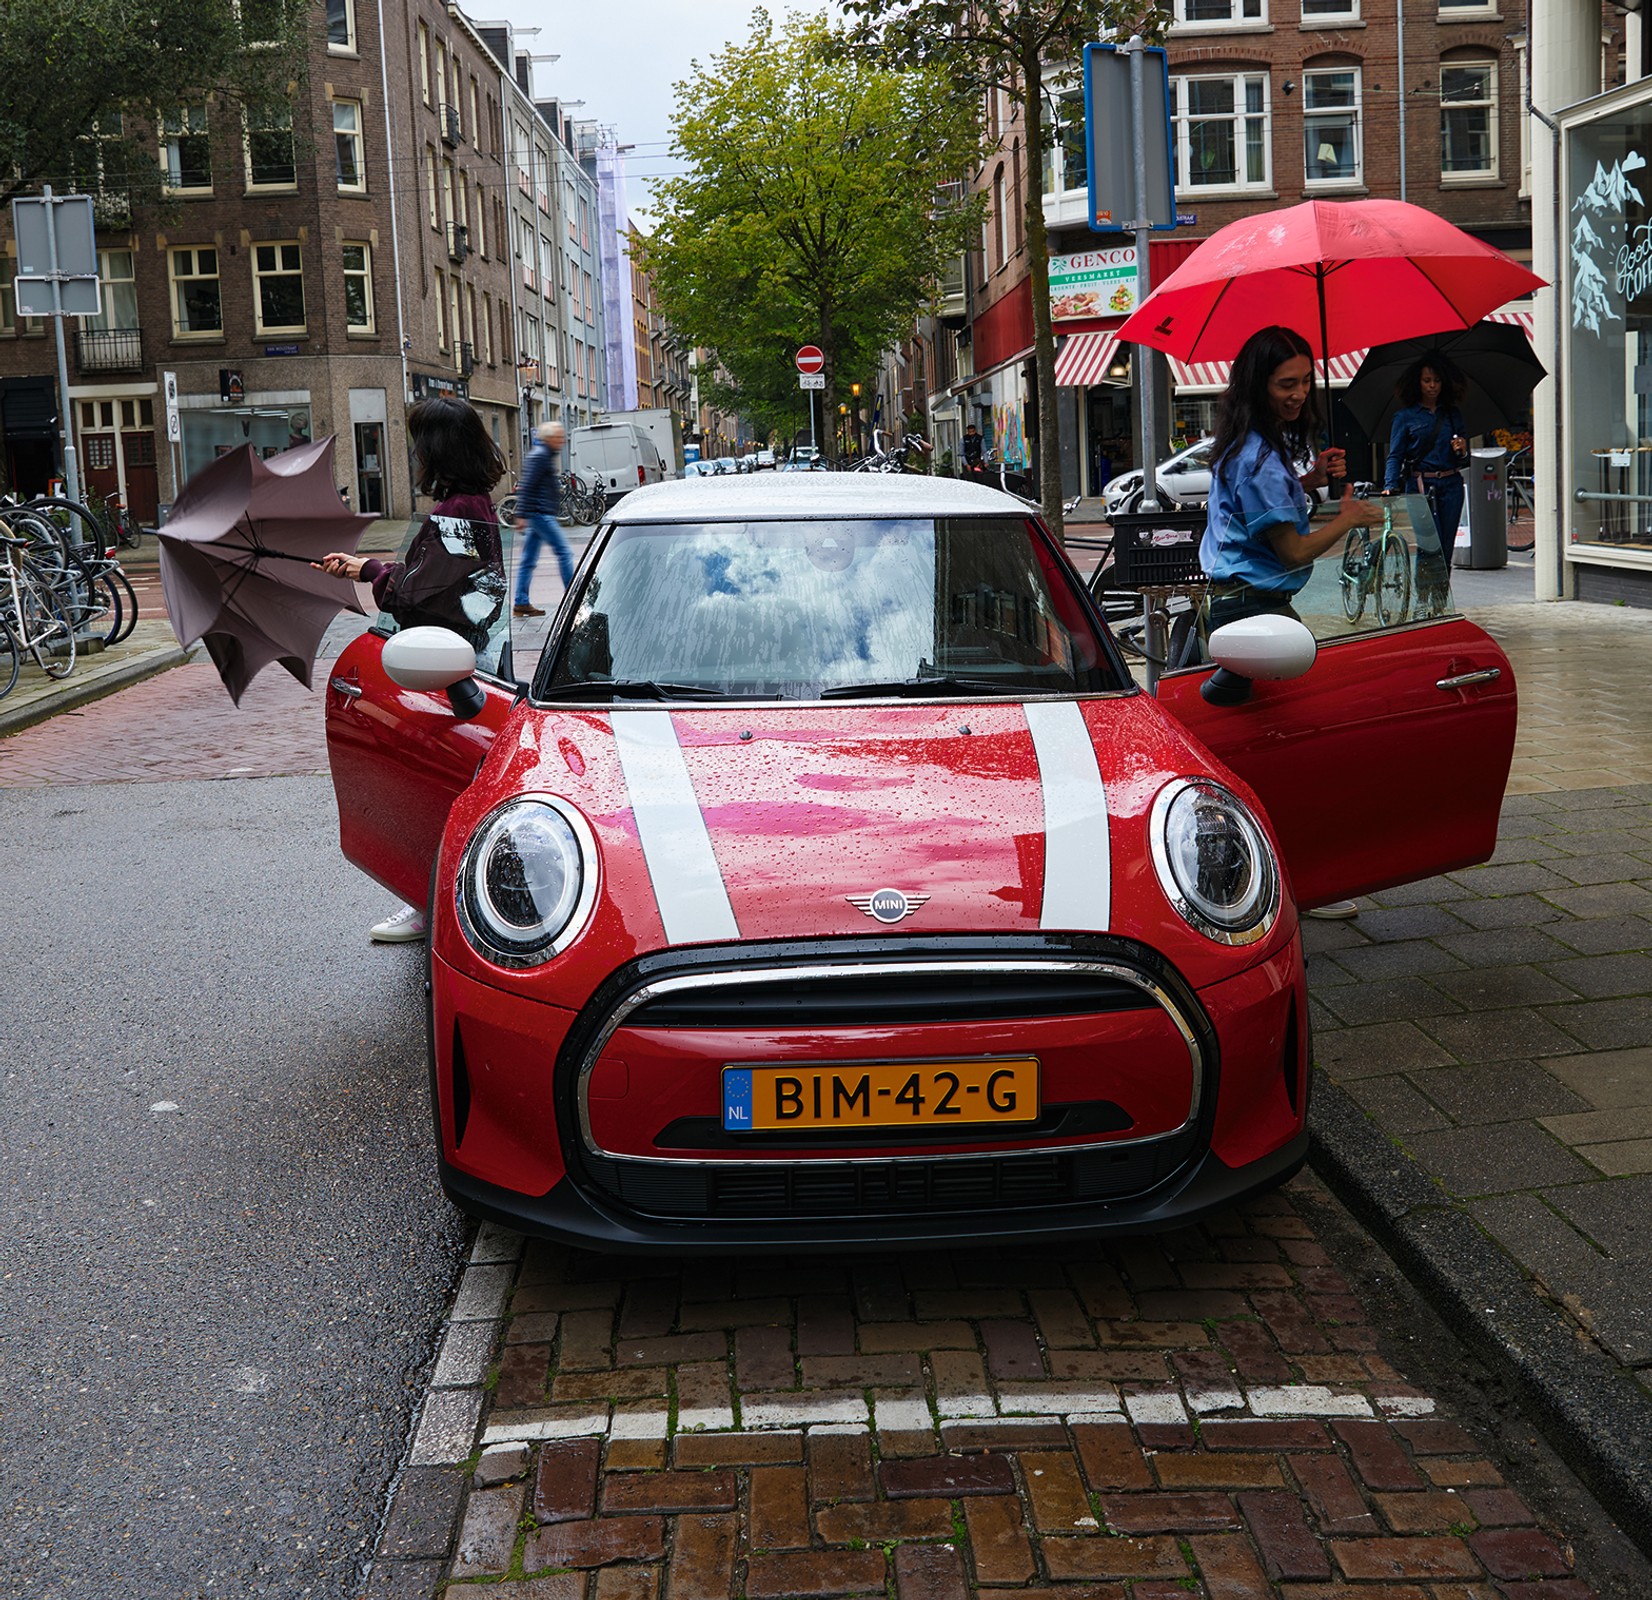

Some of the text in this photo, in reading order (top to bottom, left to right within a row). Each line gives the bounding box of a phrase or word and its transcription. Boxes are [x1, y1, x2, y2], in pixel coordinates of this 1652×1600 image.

[1070, 248, 1135, 269] GENCO
[1064, 269, 1121, 283] VERSMARKT
[874, 899, 904, 910] MINI
[775, 1068, 1017, 1120] BIM-42-G
[728, 1105, 749, 1120] NL
